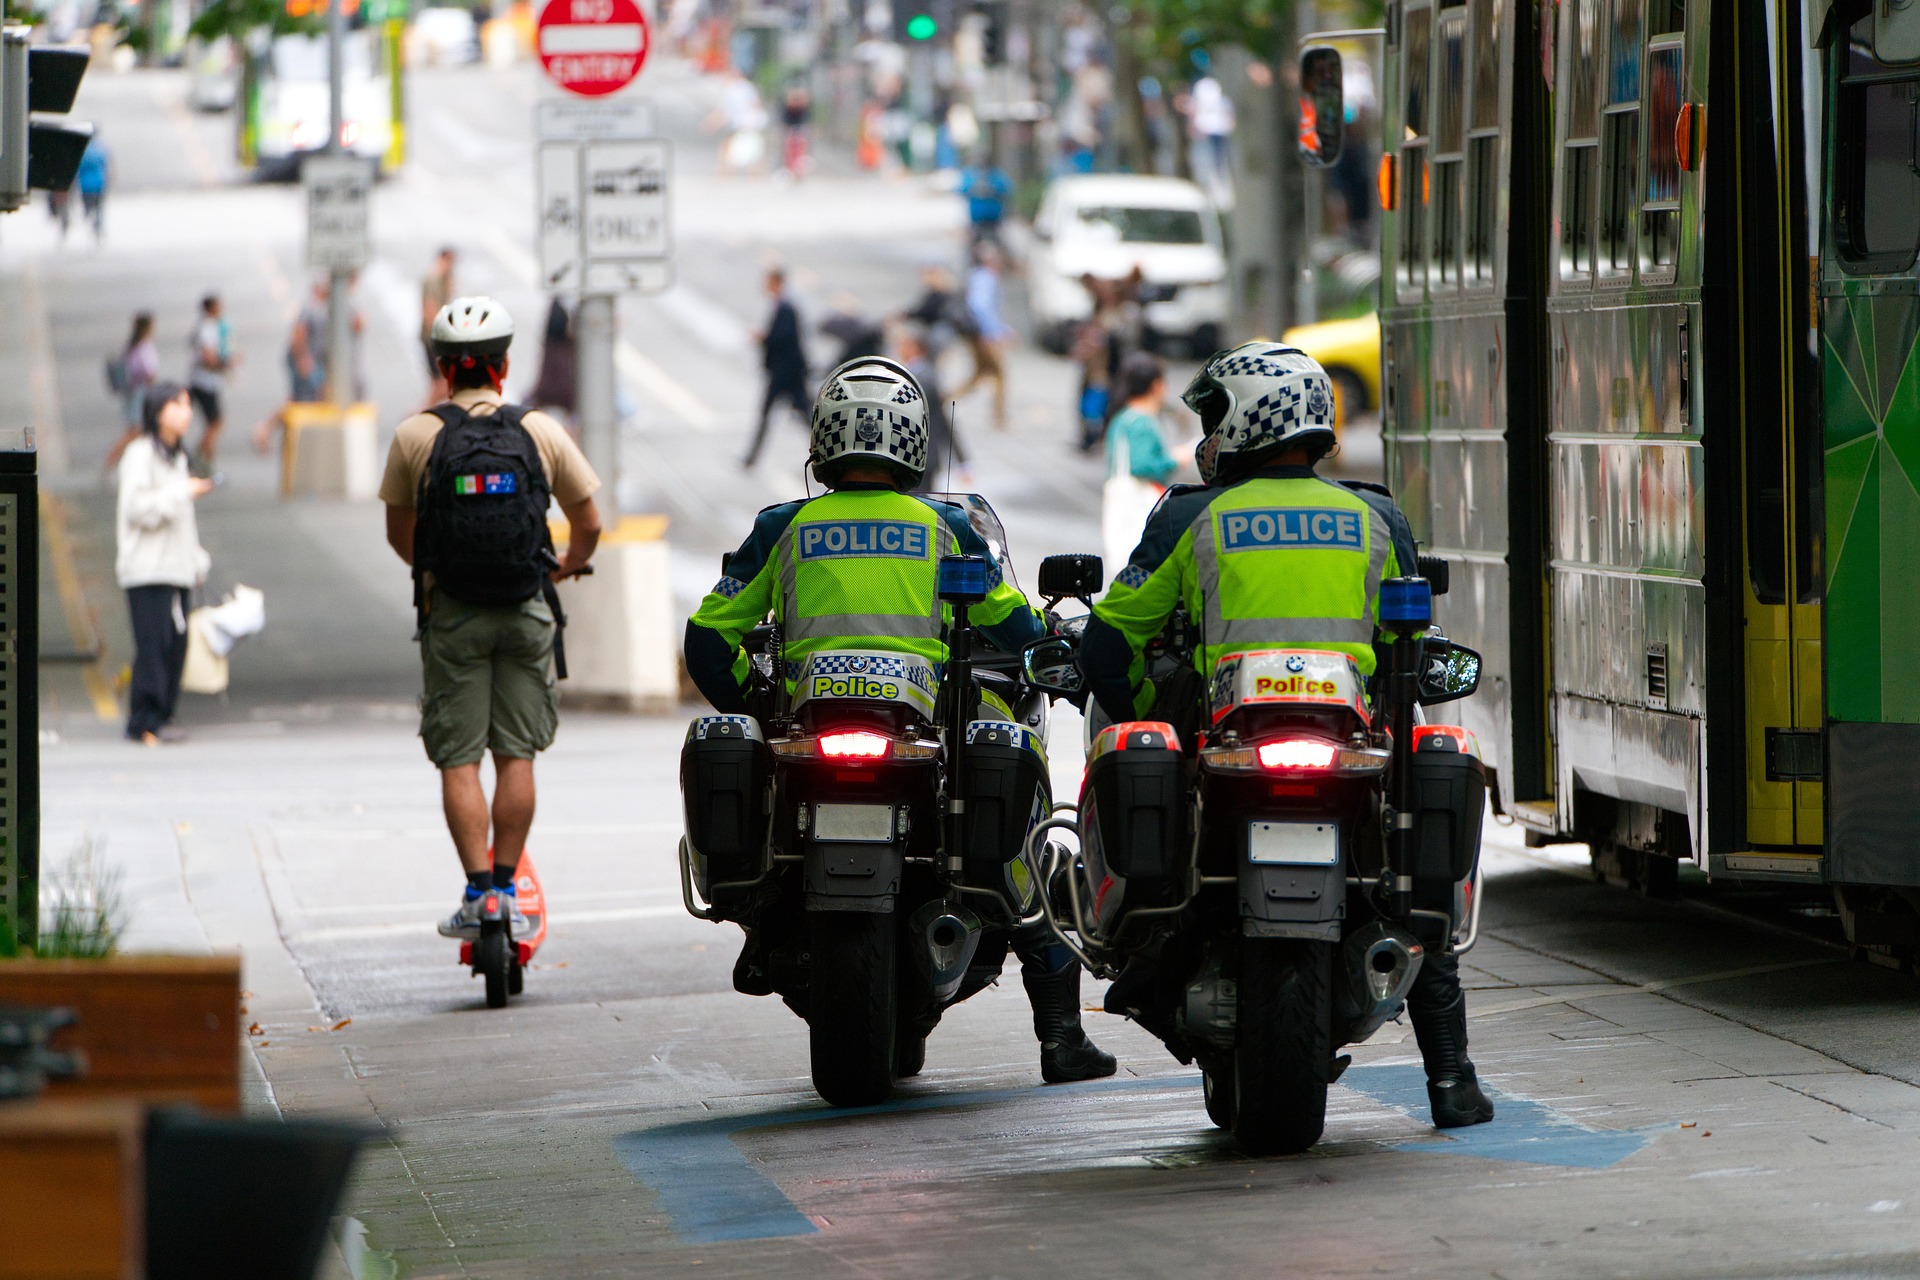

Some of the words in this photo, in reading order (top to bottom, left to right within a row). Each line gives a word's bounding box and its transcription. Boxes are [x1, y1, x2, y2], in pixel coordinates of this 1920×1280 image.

[570, 0, 614, 22] NO
[548, 56, 637, 82] ENTRY
[804, 526, 922, 554] POLICE
[1227, 513, 1357, 544] POLICE
[813, 676, 899, 699] Police
[1256, 676, 1337, 695] Police
